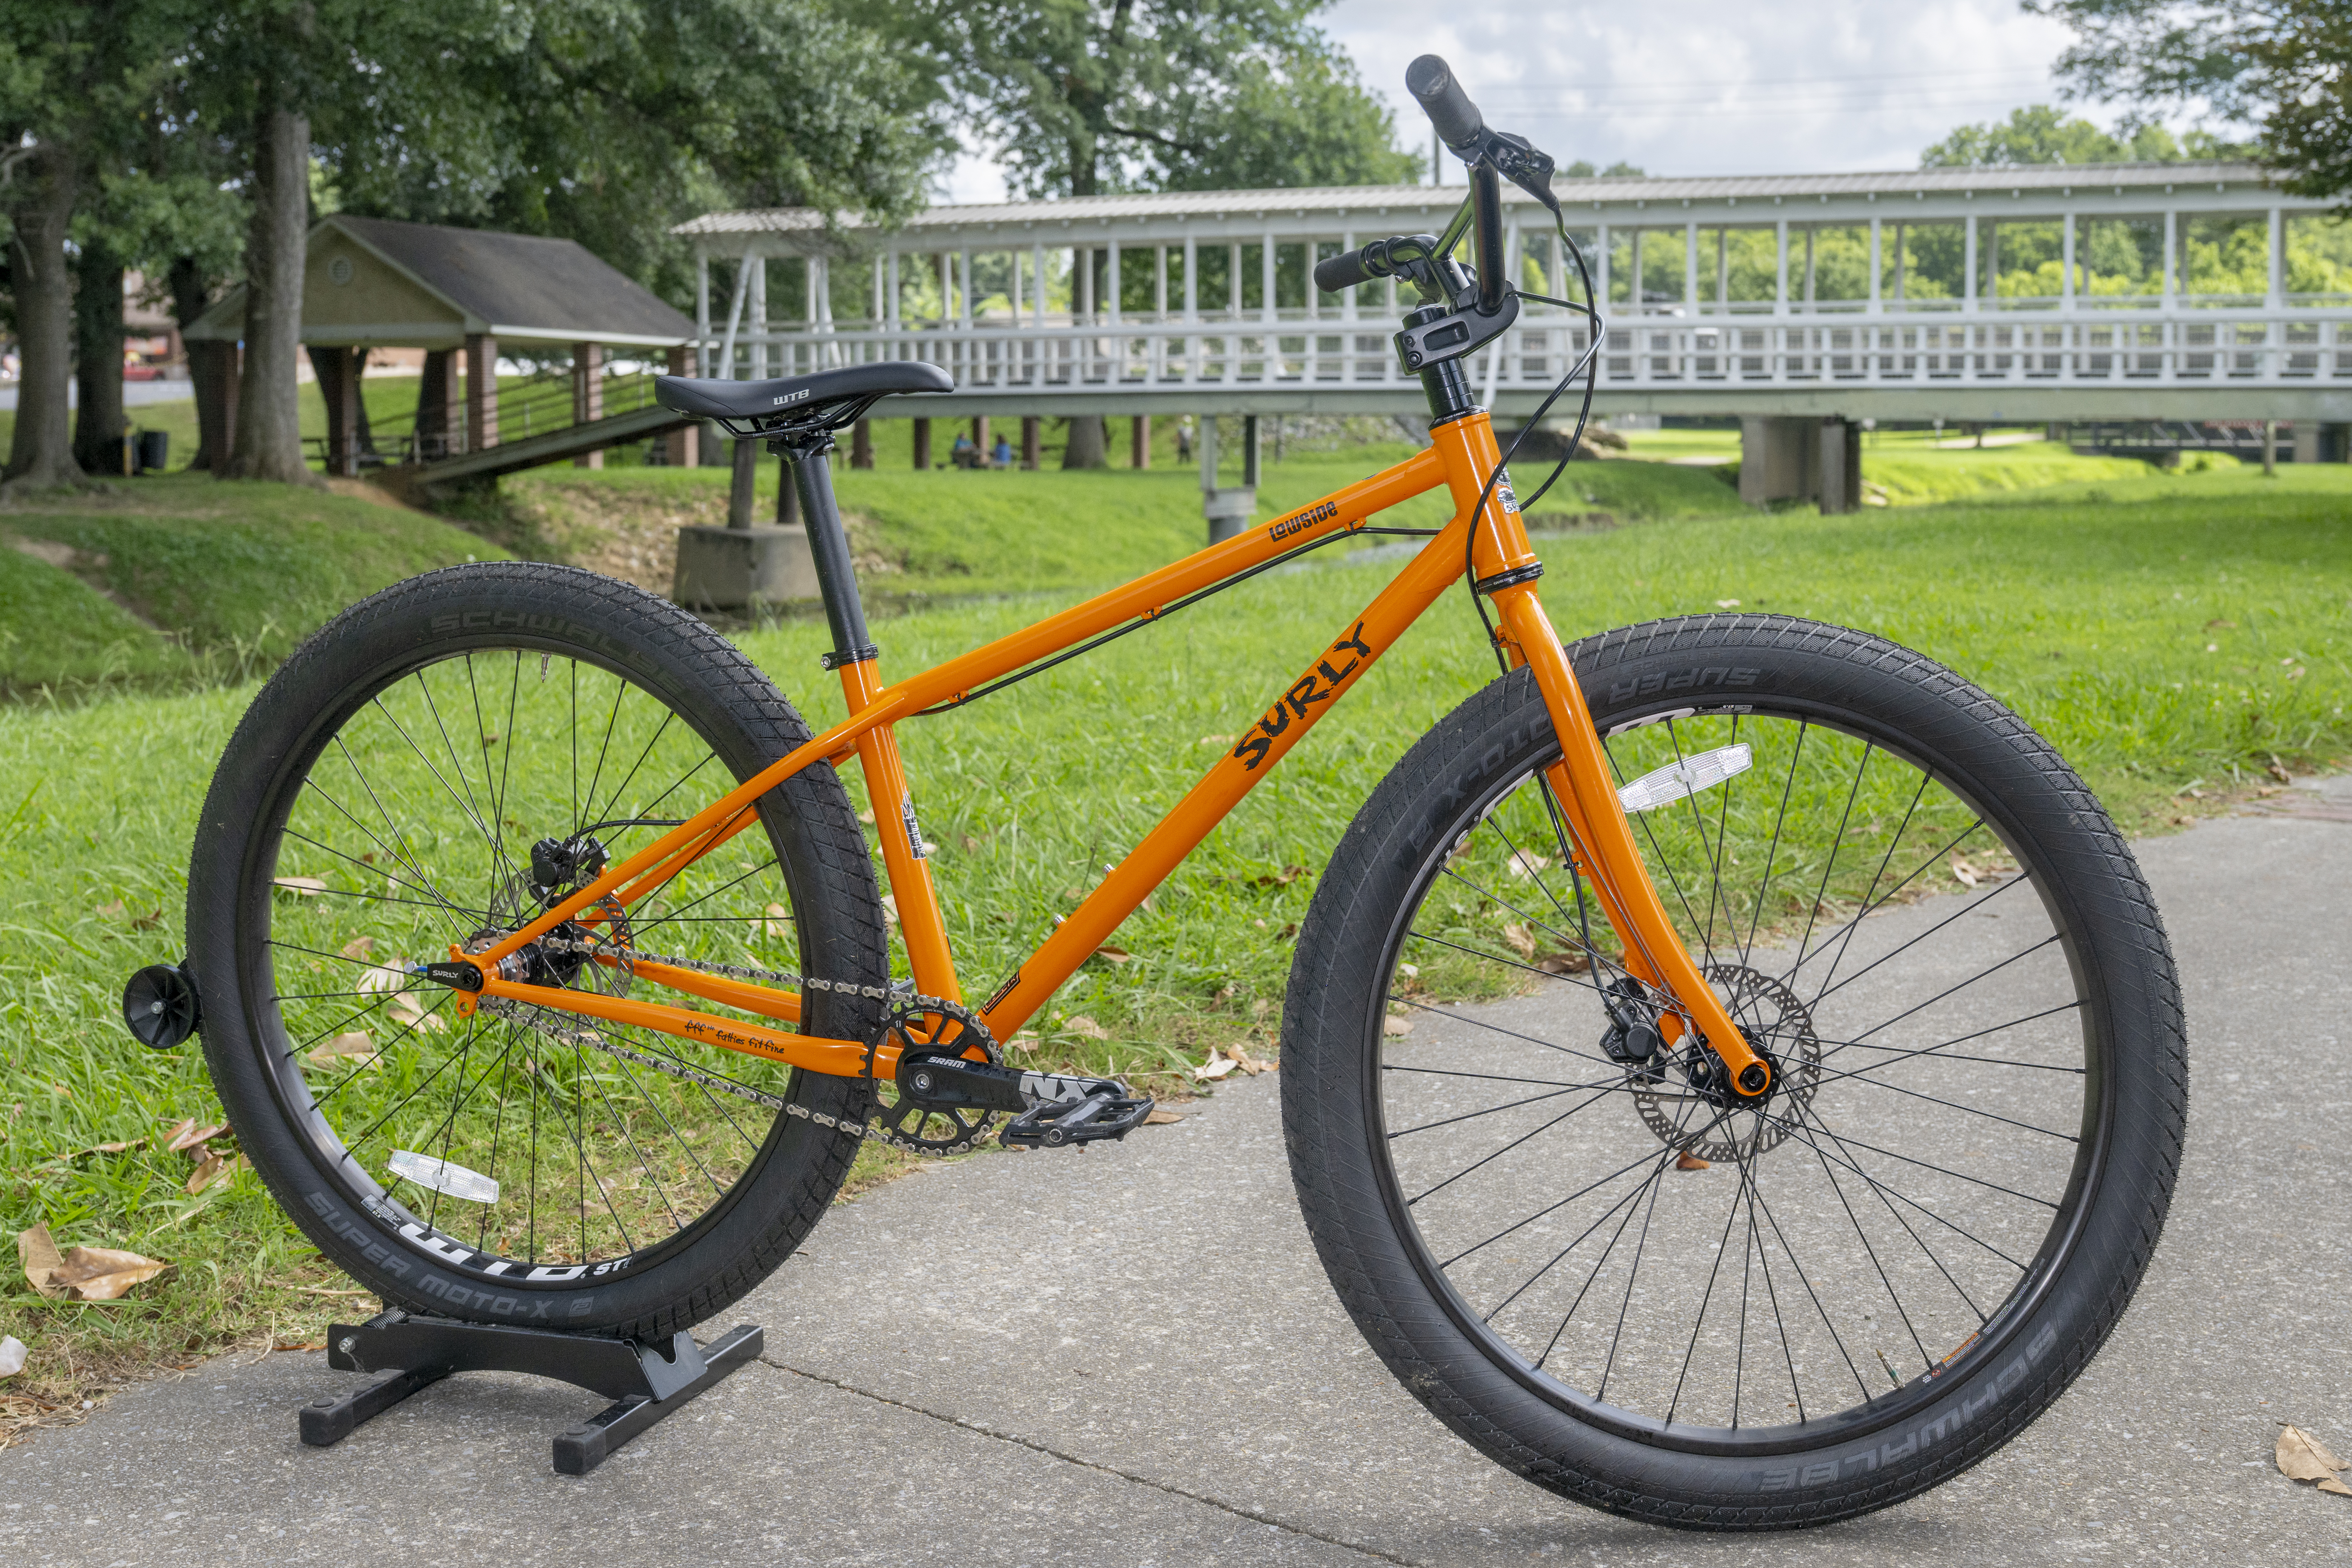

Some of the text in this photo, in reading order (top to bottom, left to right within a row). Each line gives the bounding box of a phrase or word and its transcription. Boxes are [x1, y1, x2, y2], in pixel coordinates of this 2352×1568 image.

[773, 389, 809, 405] WTB
[1233, 621, 1371, 771] SURLY
[1609, 668, 1761, 704] SUPER
[433, 970, 458, 978] SURLY
[927, 1056, 966, 1069] SRAM
[1019, 1070, 1103, 1103] NX
[305, 1192, 555, 1319] SUPER MOTO-X
[593, 1258, 628, 1275] ST
[1950, 1334, 1976, 1356] WARNING
[1760, 1321, 2054, 1492] SCHWALBE
